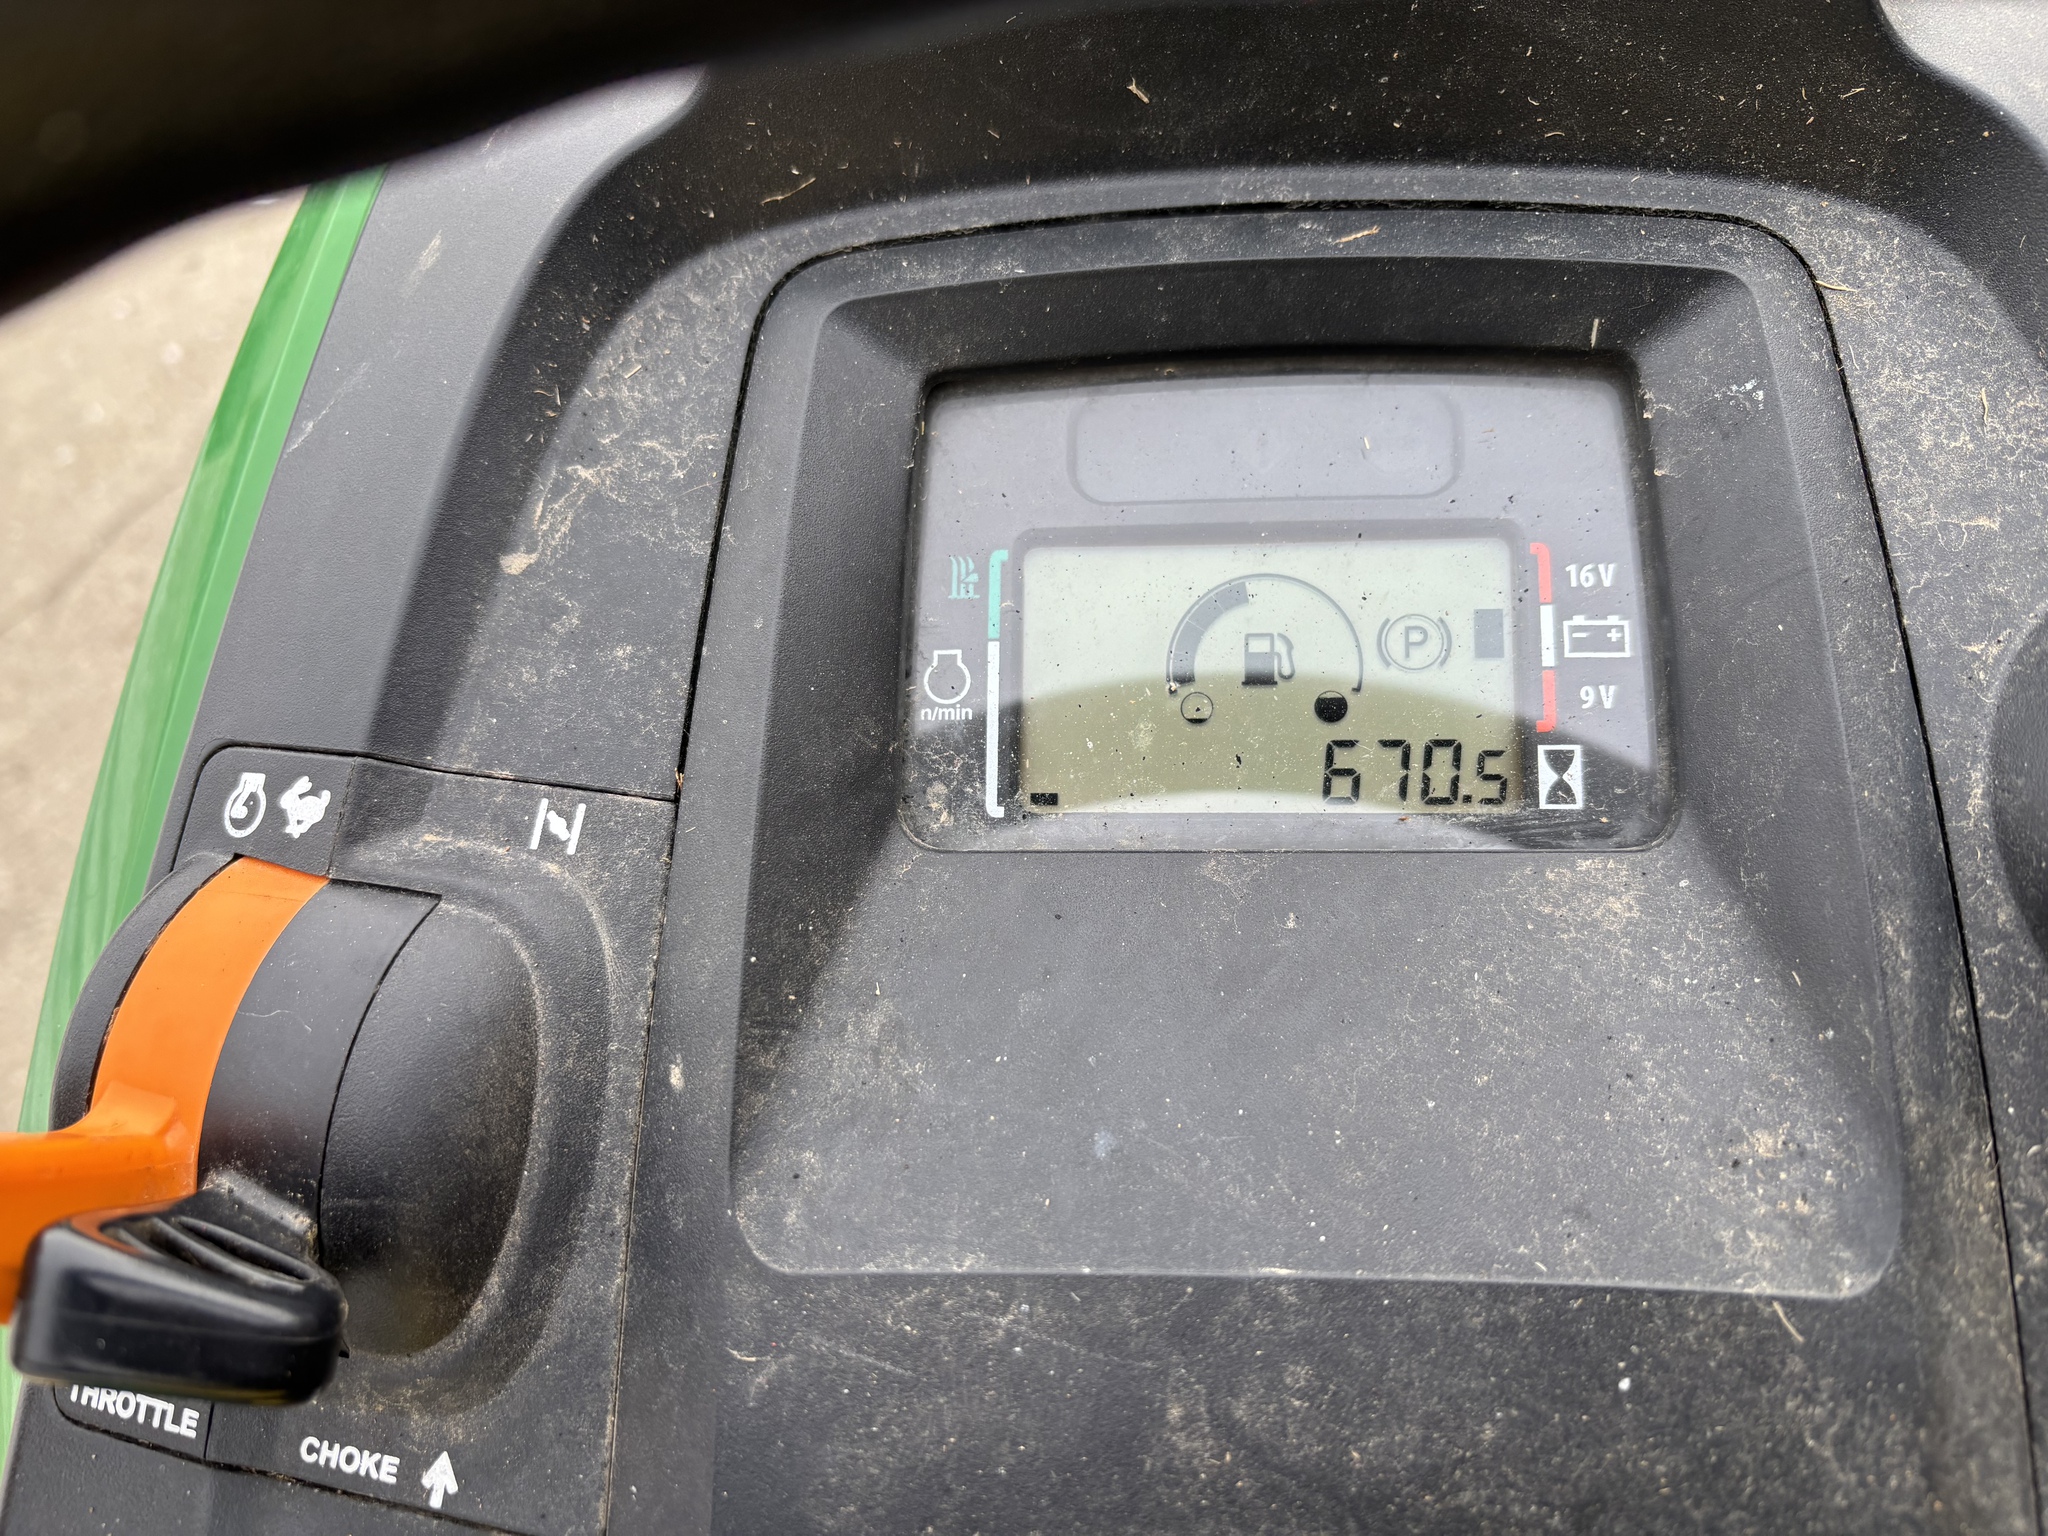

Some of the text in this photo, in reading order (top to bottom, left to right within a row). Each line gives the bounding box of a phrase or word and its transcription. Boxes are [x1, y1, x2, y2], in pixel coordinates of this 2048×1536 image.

[1565, 563, 1616, 588] 16V
[1579, 685, 1616, 709] 9V
[920, 704, 973, 721] n/min
[1322, 738, 1508, 805] 670.5
[300, 1435, 400, 1485] CHOKE
